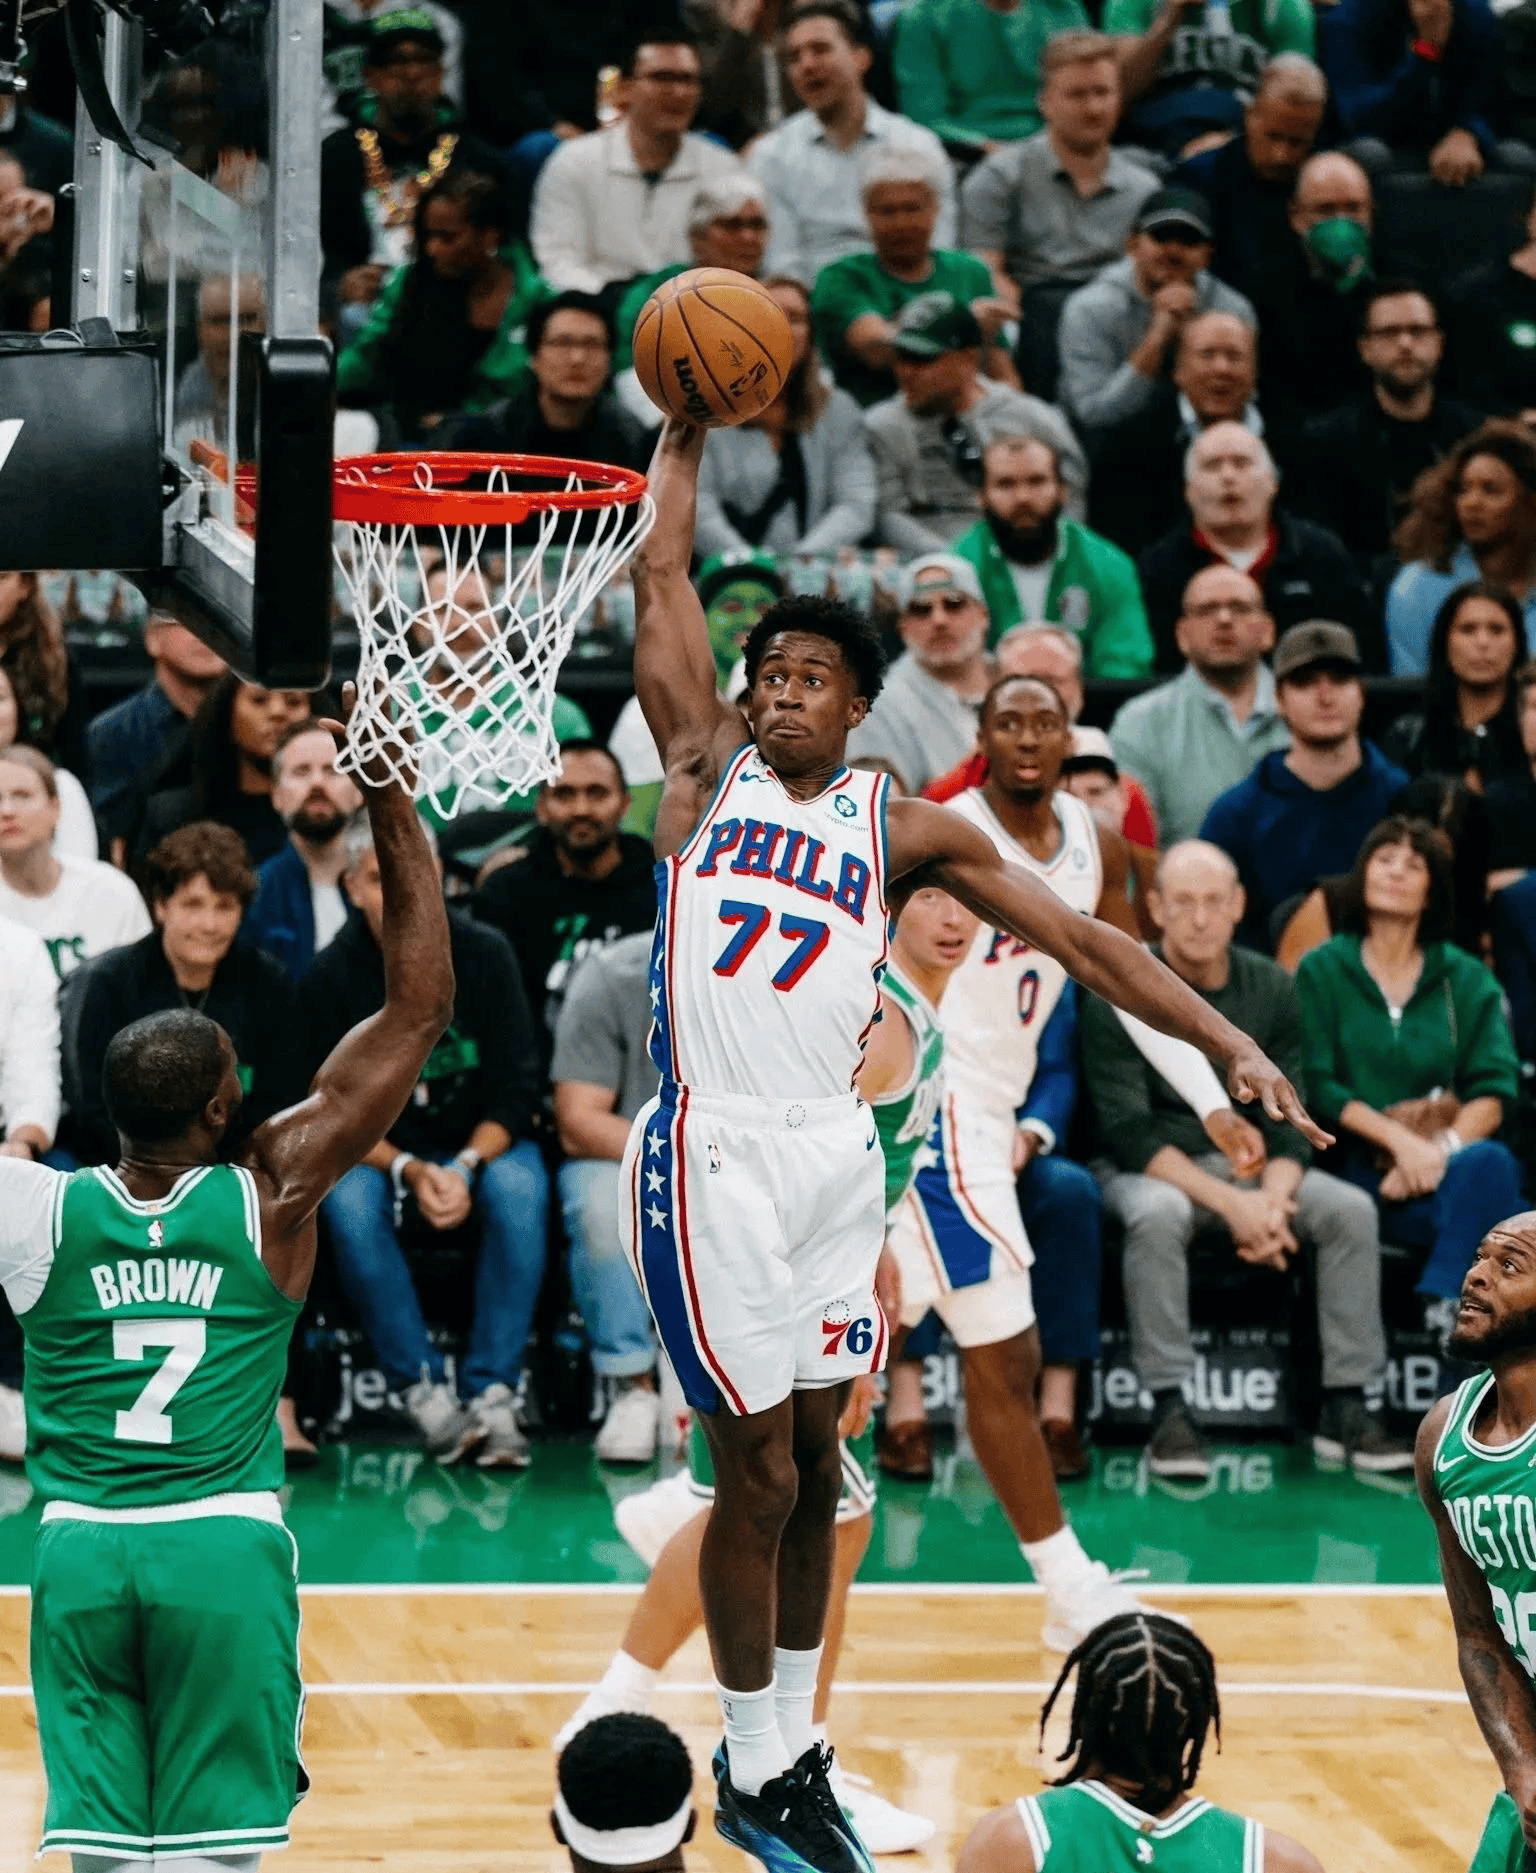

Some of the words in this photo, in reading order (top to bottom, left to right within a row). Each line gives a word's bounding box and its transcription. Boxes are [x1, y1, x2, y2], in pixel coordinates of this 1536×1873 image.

[696, 817, 871, 926] PHILA
[712, 899, 831, 993] 77
[1018, 969, 1040, 1026] 0
[90, 1258, 224, 1310] BROWN
[822, 1317, 873, 1356] 76
[112, 1317, 206, 1444] 7
[1442, 1494, 1536, 1571] OSTO
